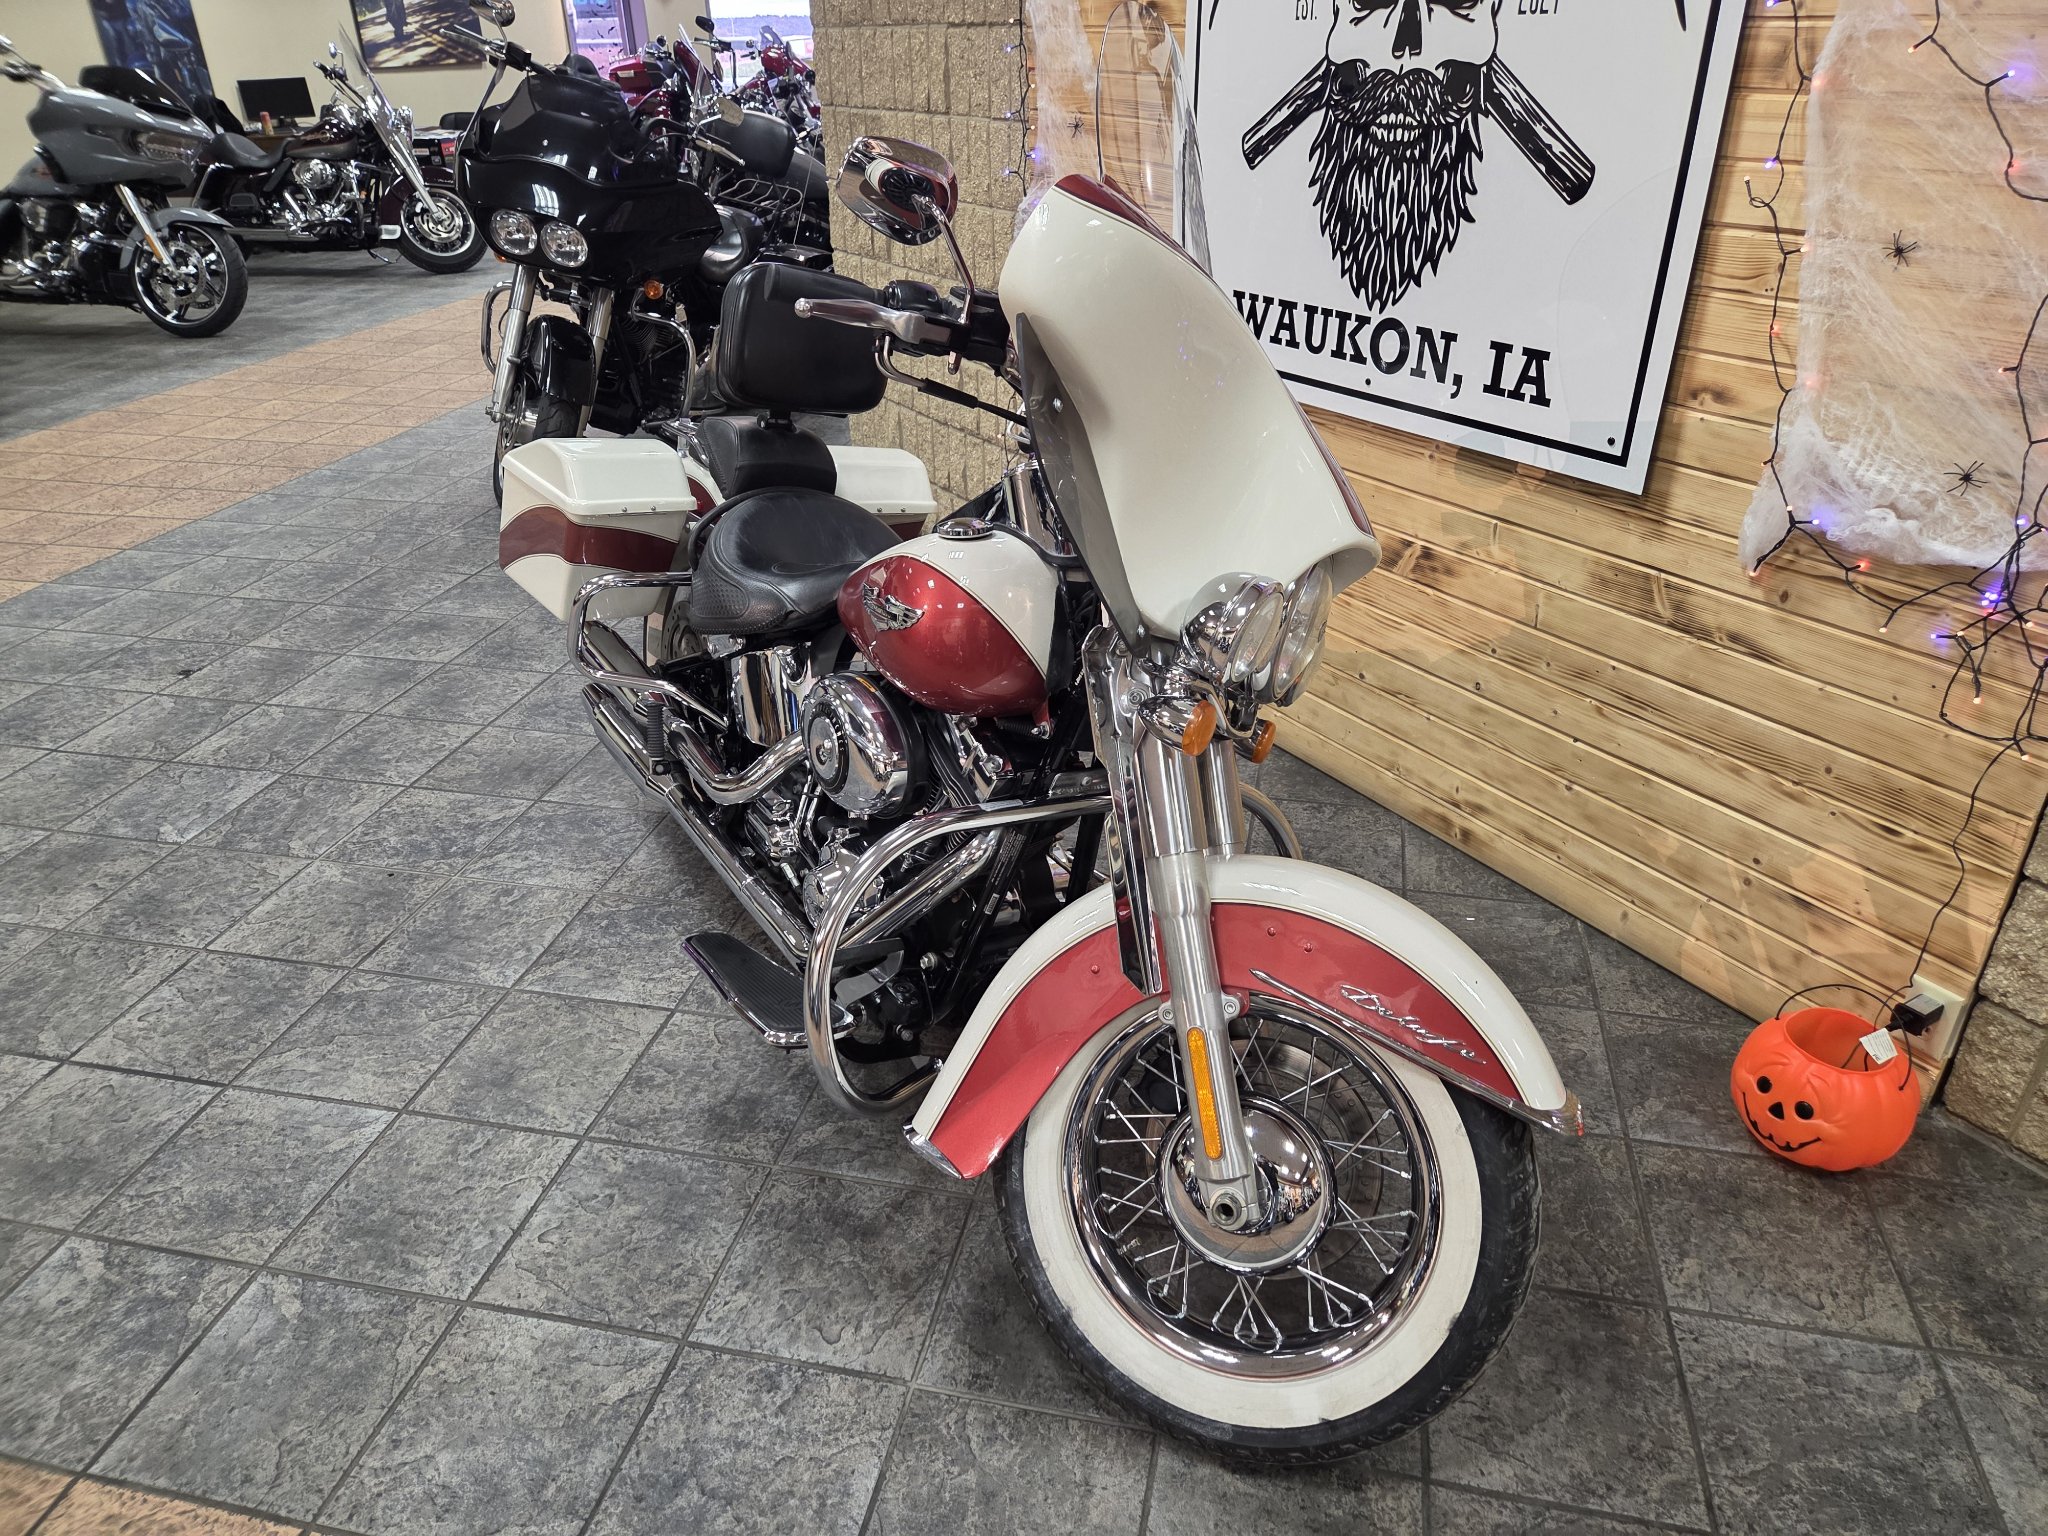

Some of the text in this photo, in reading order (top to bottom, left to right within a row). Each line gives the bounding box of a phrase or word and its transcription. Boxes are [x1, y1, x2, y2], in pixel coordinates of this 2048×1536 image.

[1233, 289, 1551, 408] WAUKON, IA
[1340, 984, 1486, 1064] Deluxe
